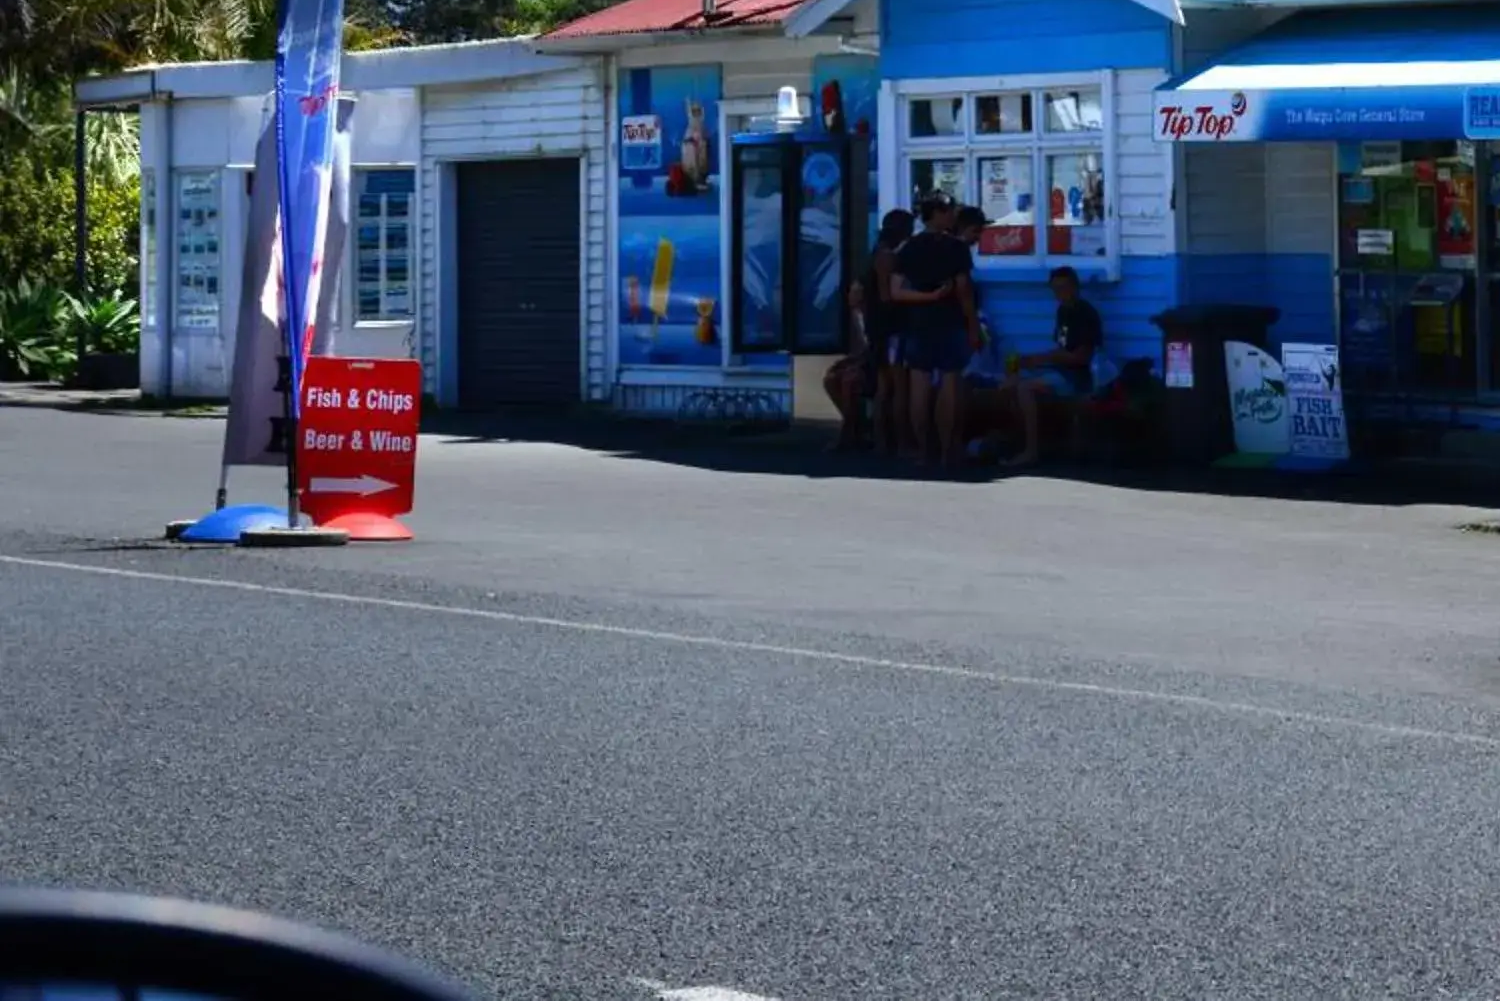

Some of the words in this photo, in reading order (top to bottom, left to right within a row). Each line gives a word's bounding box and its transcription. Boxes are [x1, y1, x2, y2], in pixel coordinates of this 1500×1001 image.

[1159, 105, 1194, 141] Tip
[1195, 105, 1235, 140] Top
[306, 386, 341, 408] Fish
[347, 387, 361, 409] &
[366, 388, 414, 415] Chips
[1295, 397, 1333, 415] FISH
[1293, 415, 1341, 438] BAIT
[303, 428, 345, 450] Beer
[351, 429, 364, 450] &
[369, 429, 413, 452] Wine
